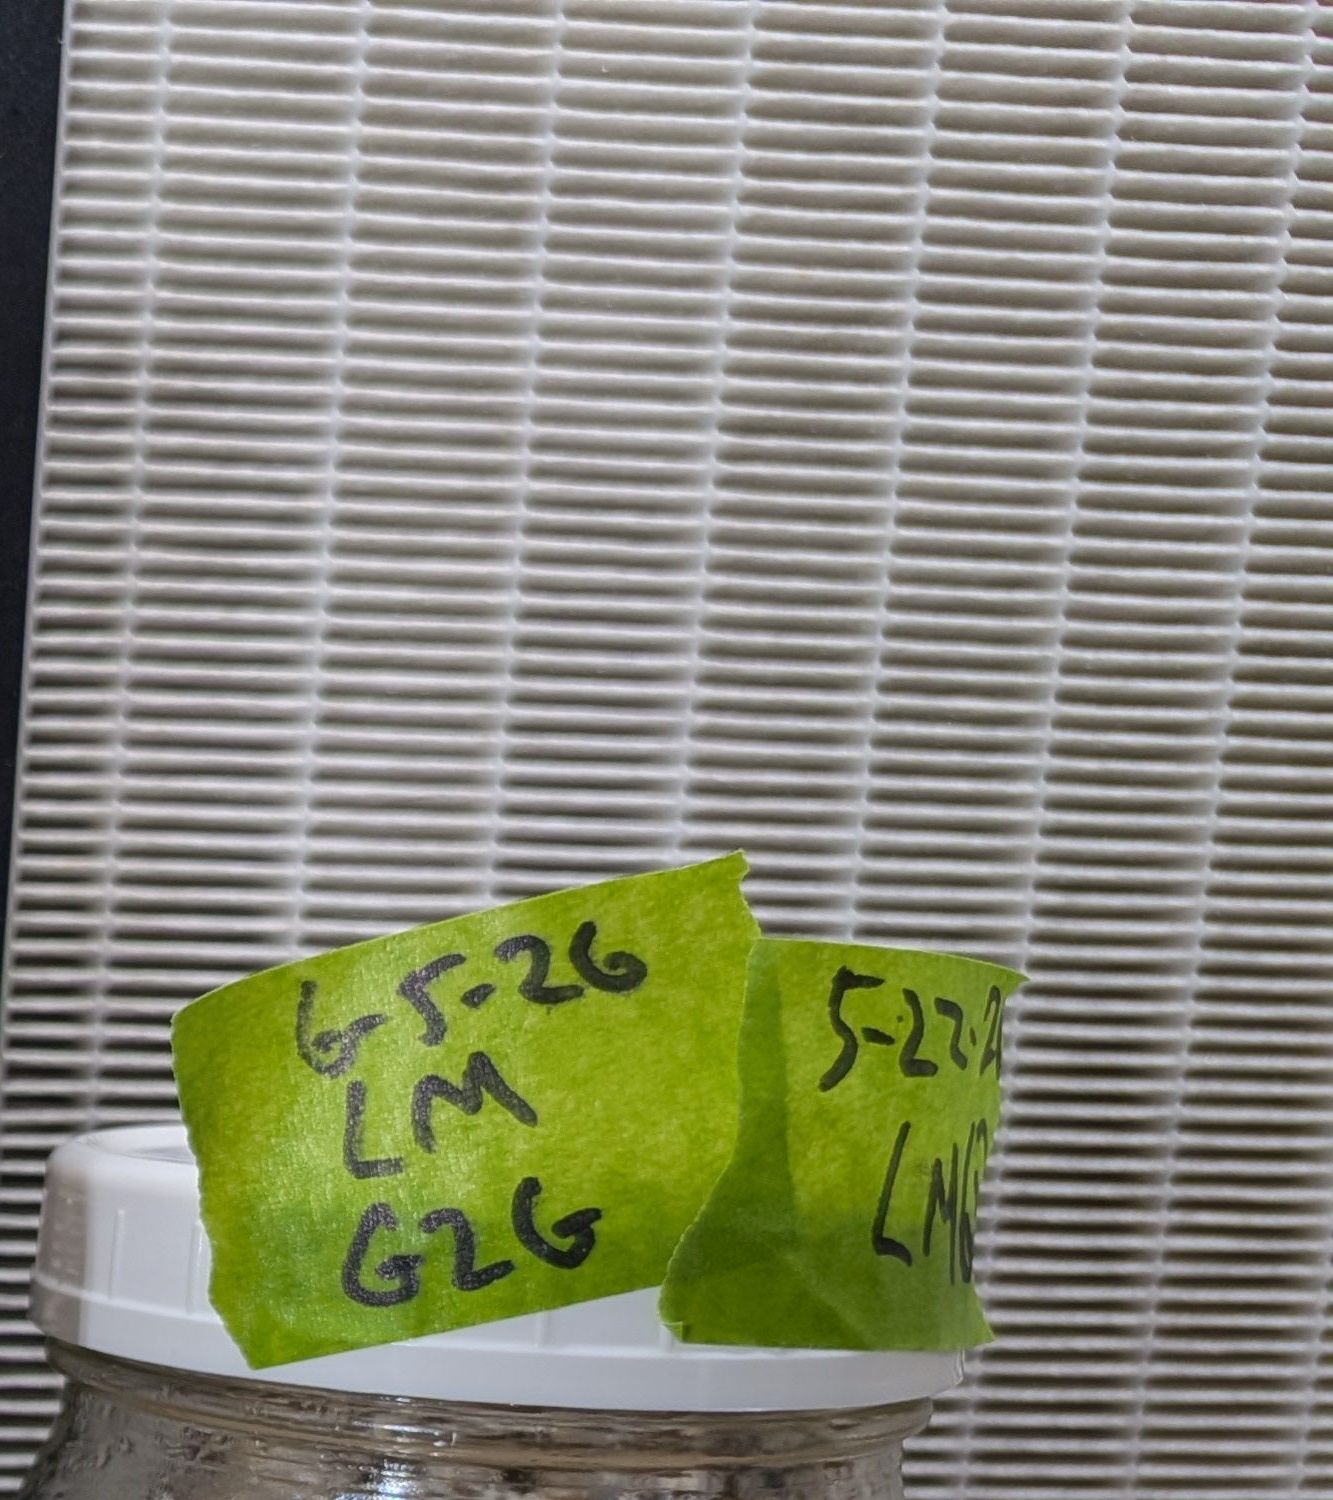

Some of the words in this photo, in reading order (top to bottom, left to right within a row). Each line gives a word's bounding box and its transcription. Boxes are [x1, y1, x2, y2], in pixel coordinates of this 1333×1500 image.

[293, 920, 649, 1080] 6-5-26
[343, 1050, 541, 1182] LM
[337, 1176, 605, 1310] G2G
